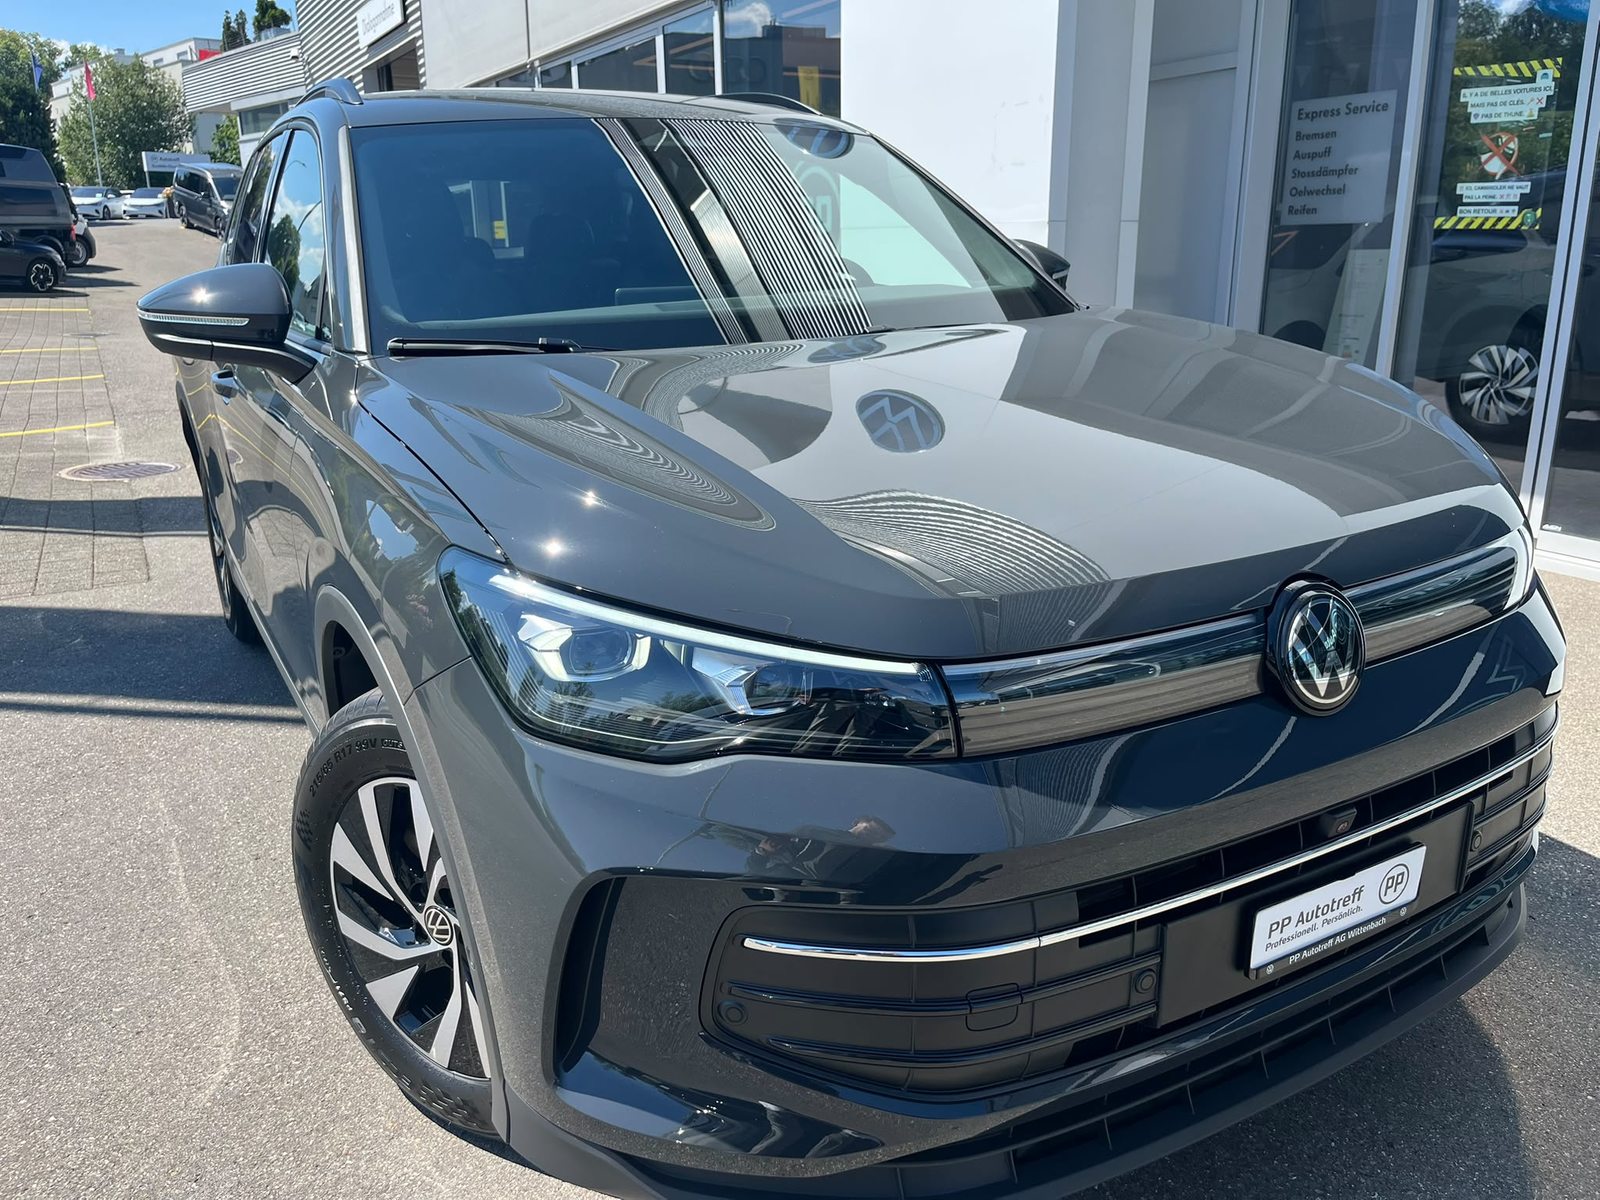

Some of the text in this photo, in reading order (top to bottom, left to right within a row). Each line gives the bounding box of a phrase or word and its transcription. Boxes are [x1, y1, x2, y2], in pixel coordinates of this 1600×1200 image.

[1512, 86, 1542, 95] VOITURES
[1297, 100, 1389, 122] Express Service
[1295, 130, 1337, 141] Bremsen
[1292, 146, 1332, 161] Auspuff
[1291, 163, 1359, 179] Stossdämpfer
[1289, 184, 1346, 198] Oelwechsel
[1287, 205, 1317, 216] Reifen
[310, 738, 406, 798] 215/65 R17 99V OUTS
[1267, 884, 1365, 940] PP Autotreff
[1264, 905, 1363, 952] Professionell. Persönlich.
[1289, 917, 1386, 964] PP Autotreff AG Wittenbach
